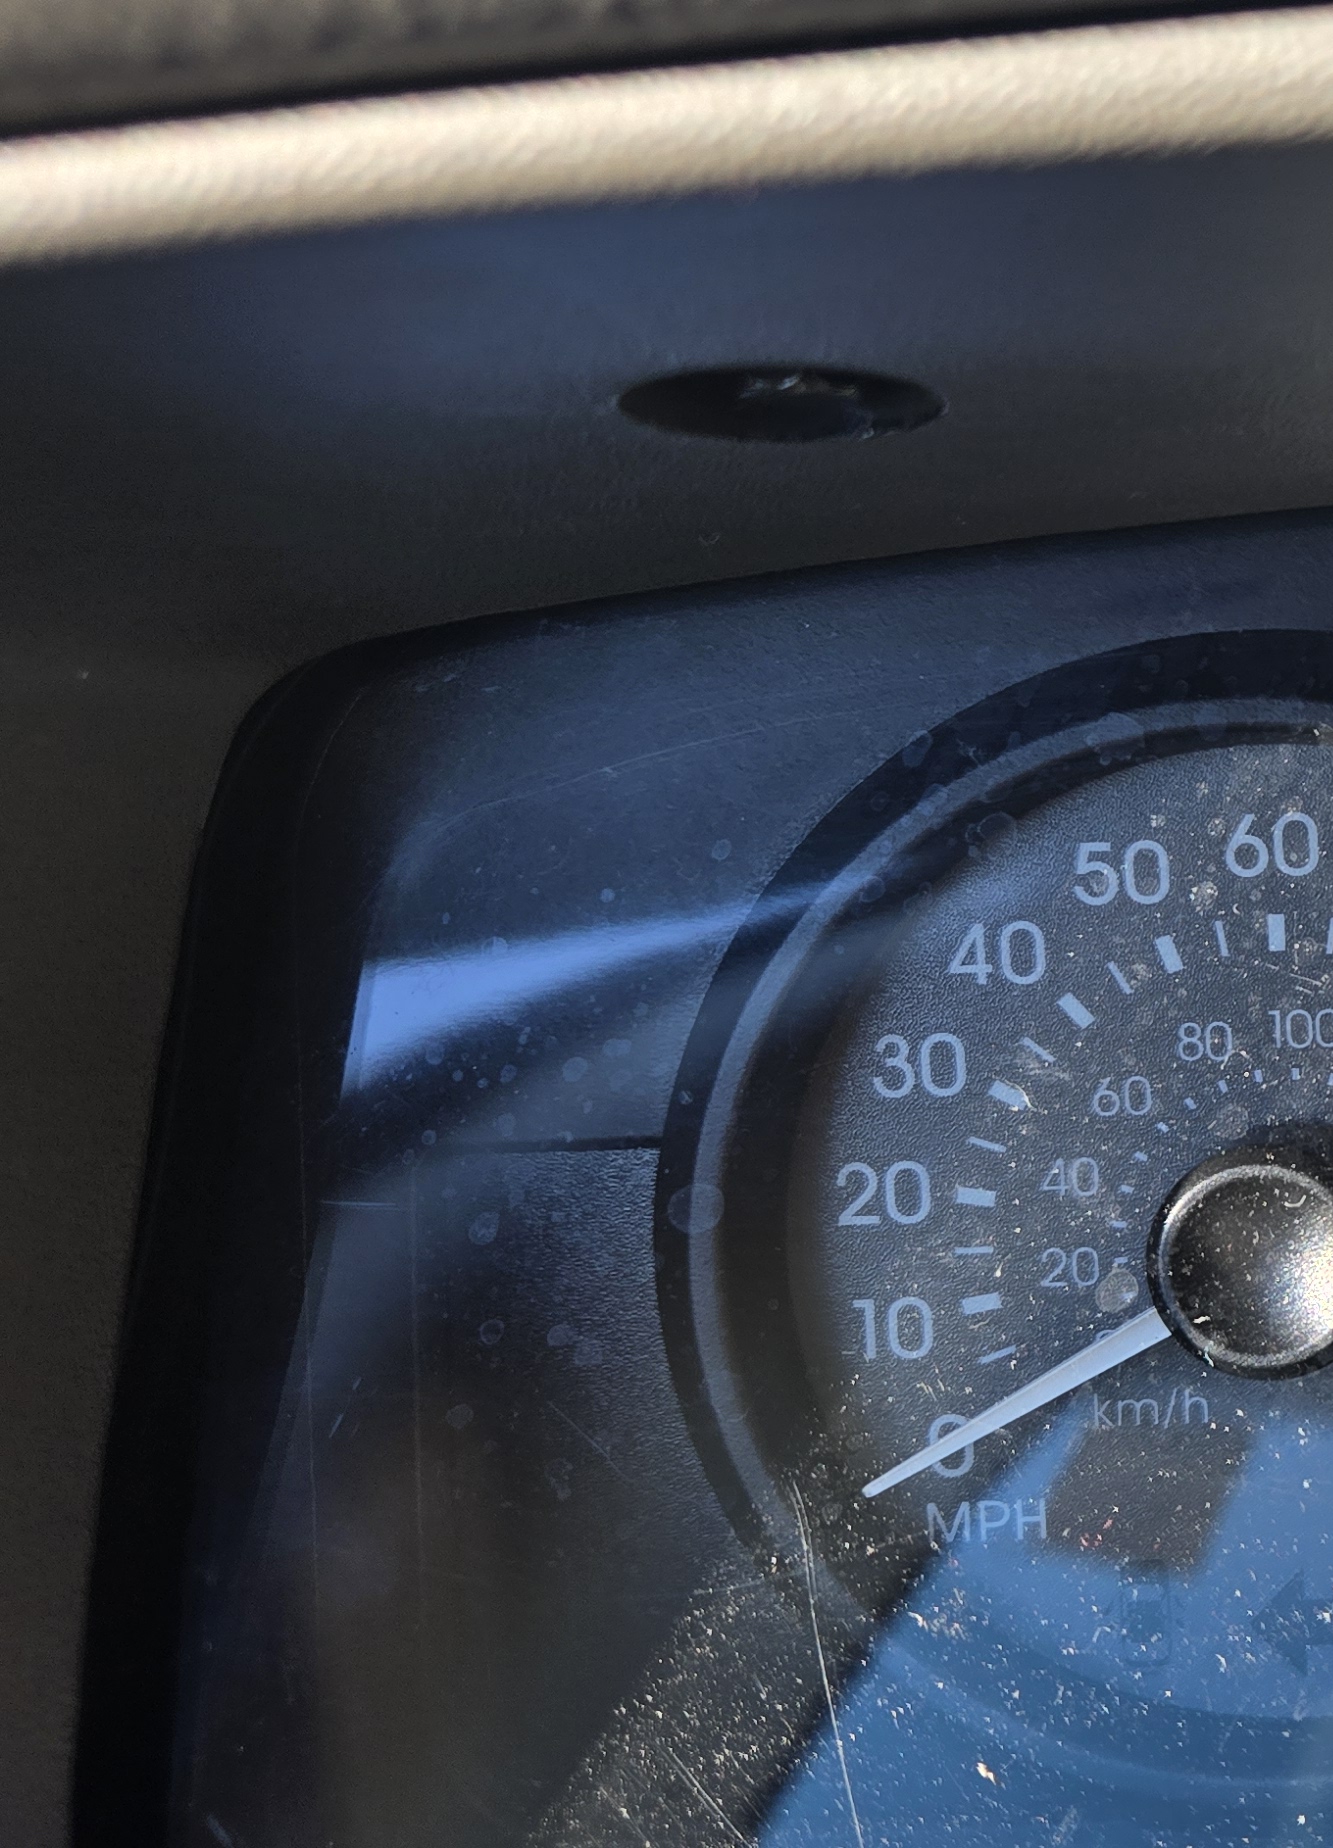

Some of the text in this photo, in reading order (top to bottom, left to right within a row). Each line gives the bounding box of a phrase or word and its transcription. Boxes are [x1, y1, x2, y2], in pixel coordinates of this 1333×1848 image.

[1073, 840, 1170, 906] 50
[1226, 813, 1319, 878] 60
[948, 920, 1046, 985] 40
[873, 1033, 967, 1099] 30
[1178, 1021, 1233, 1061] 80
[1093, 1075, 1152, 1116] 60
[836, 1160, 931, 1226] 20
[1041, 1156, 1100, 1198] 40
[1040, 1247, 1099, 1288] 20
[853, 1297, 934, 1359] 10
[1092, 1387, 1209, 1428] km/h
[929, 1413, 975, 1478] 0
[927, 1500, 1048, 1543] MPH
